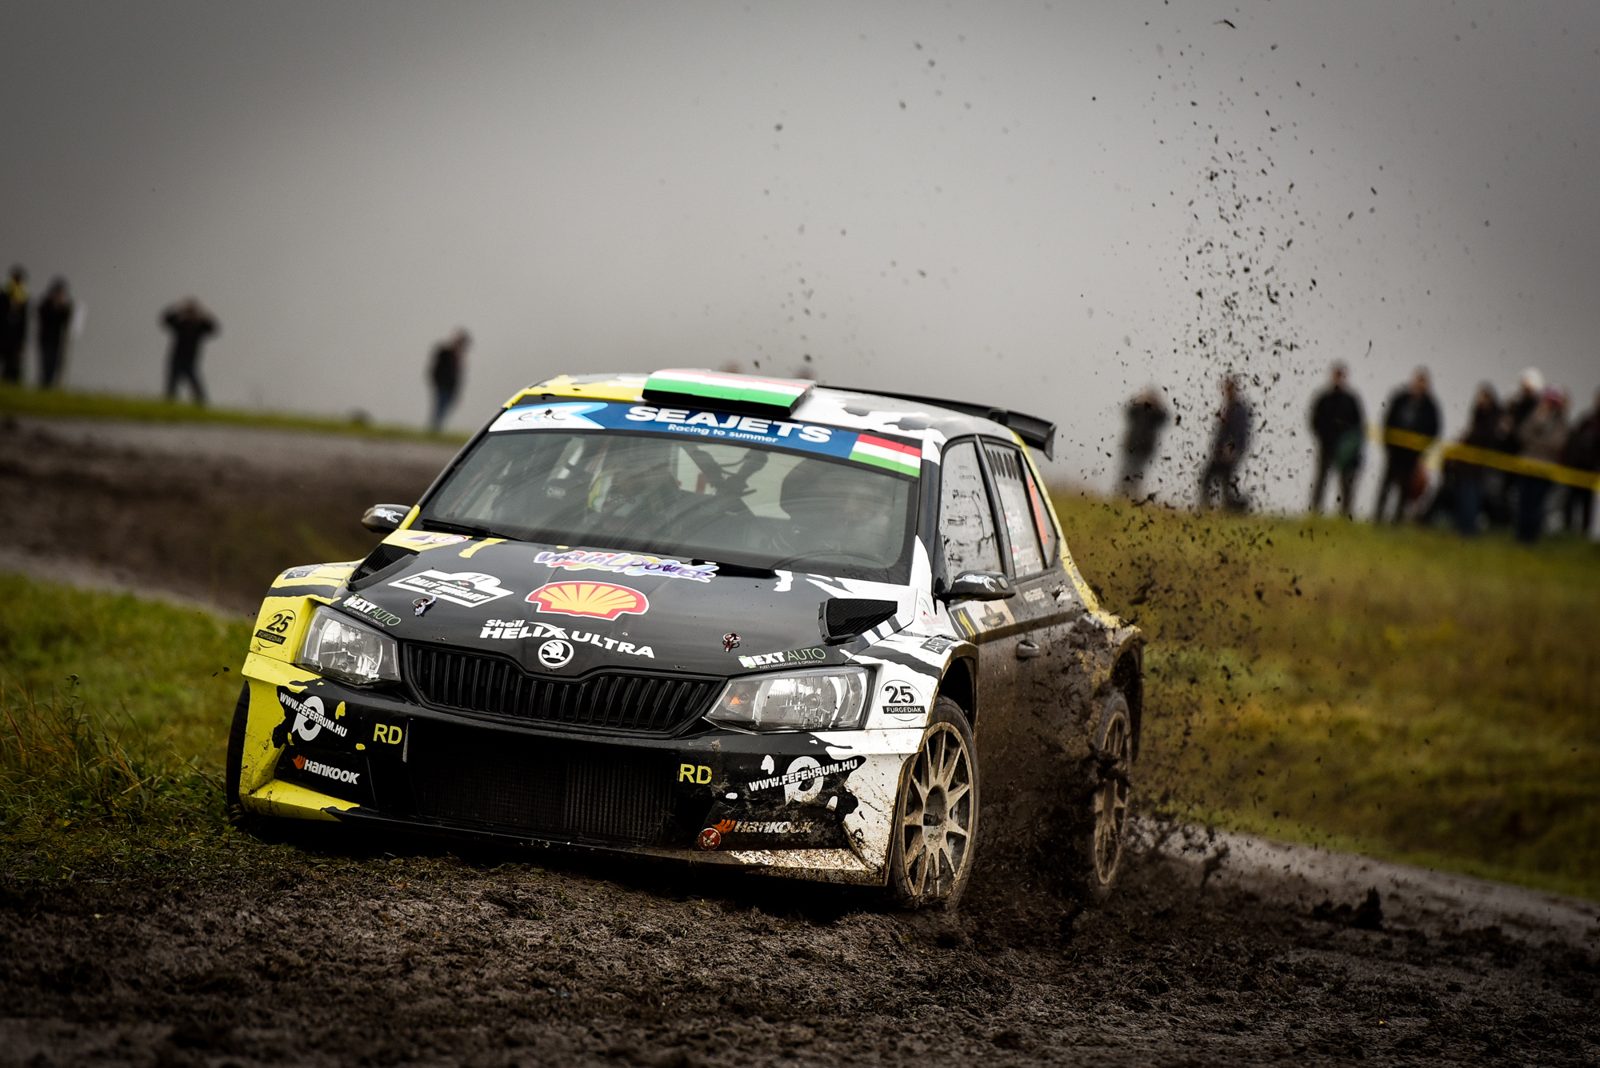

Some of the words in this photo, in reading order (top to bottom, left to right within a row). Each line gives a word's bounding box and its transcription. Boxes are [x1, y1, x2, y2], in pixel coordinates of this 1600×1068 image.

[625, 405, 833, 444] SEAJETS
[668, 423, 709, 436] Racing
[713, 427, 726, 436] to
[729, 430, 779, 443] summer
[266, 613, 293, 634] 25
[485, 619, 525, 628] Shell
[480, 621, 569, 640] HELIX
[571, 630, 655, 659] ULTRA
[885, 685, 915, 704] 25
[280, 692, 348, 738] WWW.FEFERRUM.HU
[373, 723, 403, 745] RD
[679, 763, 713, 785] RD
